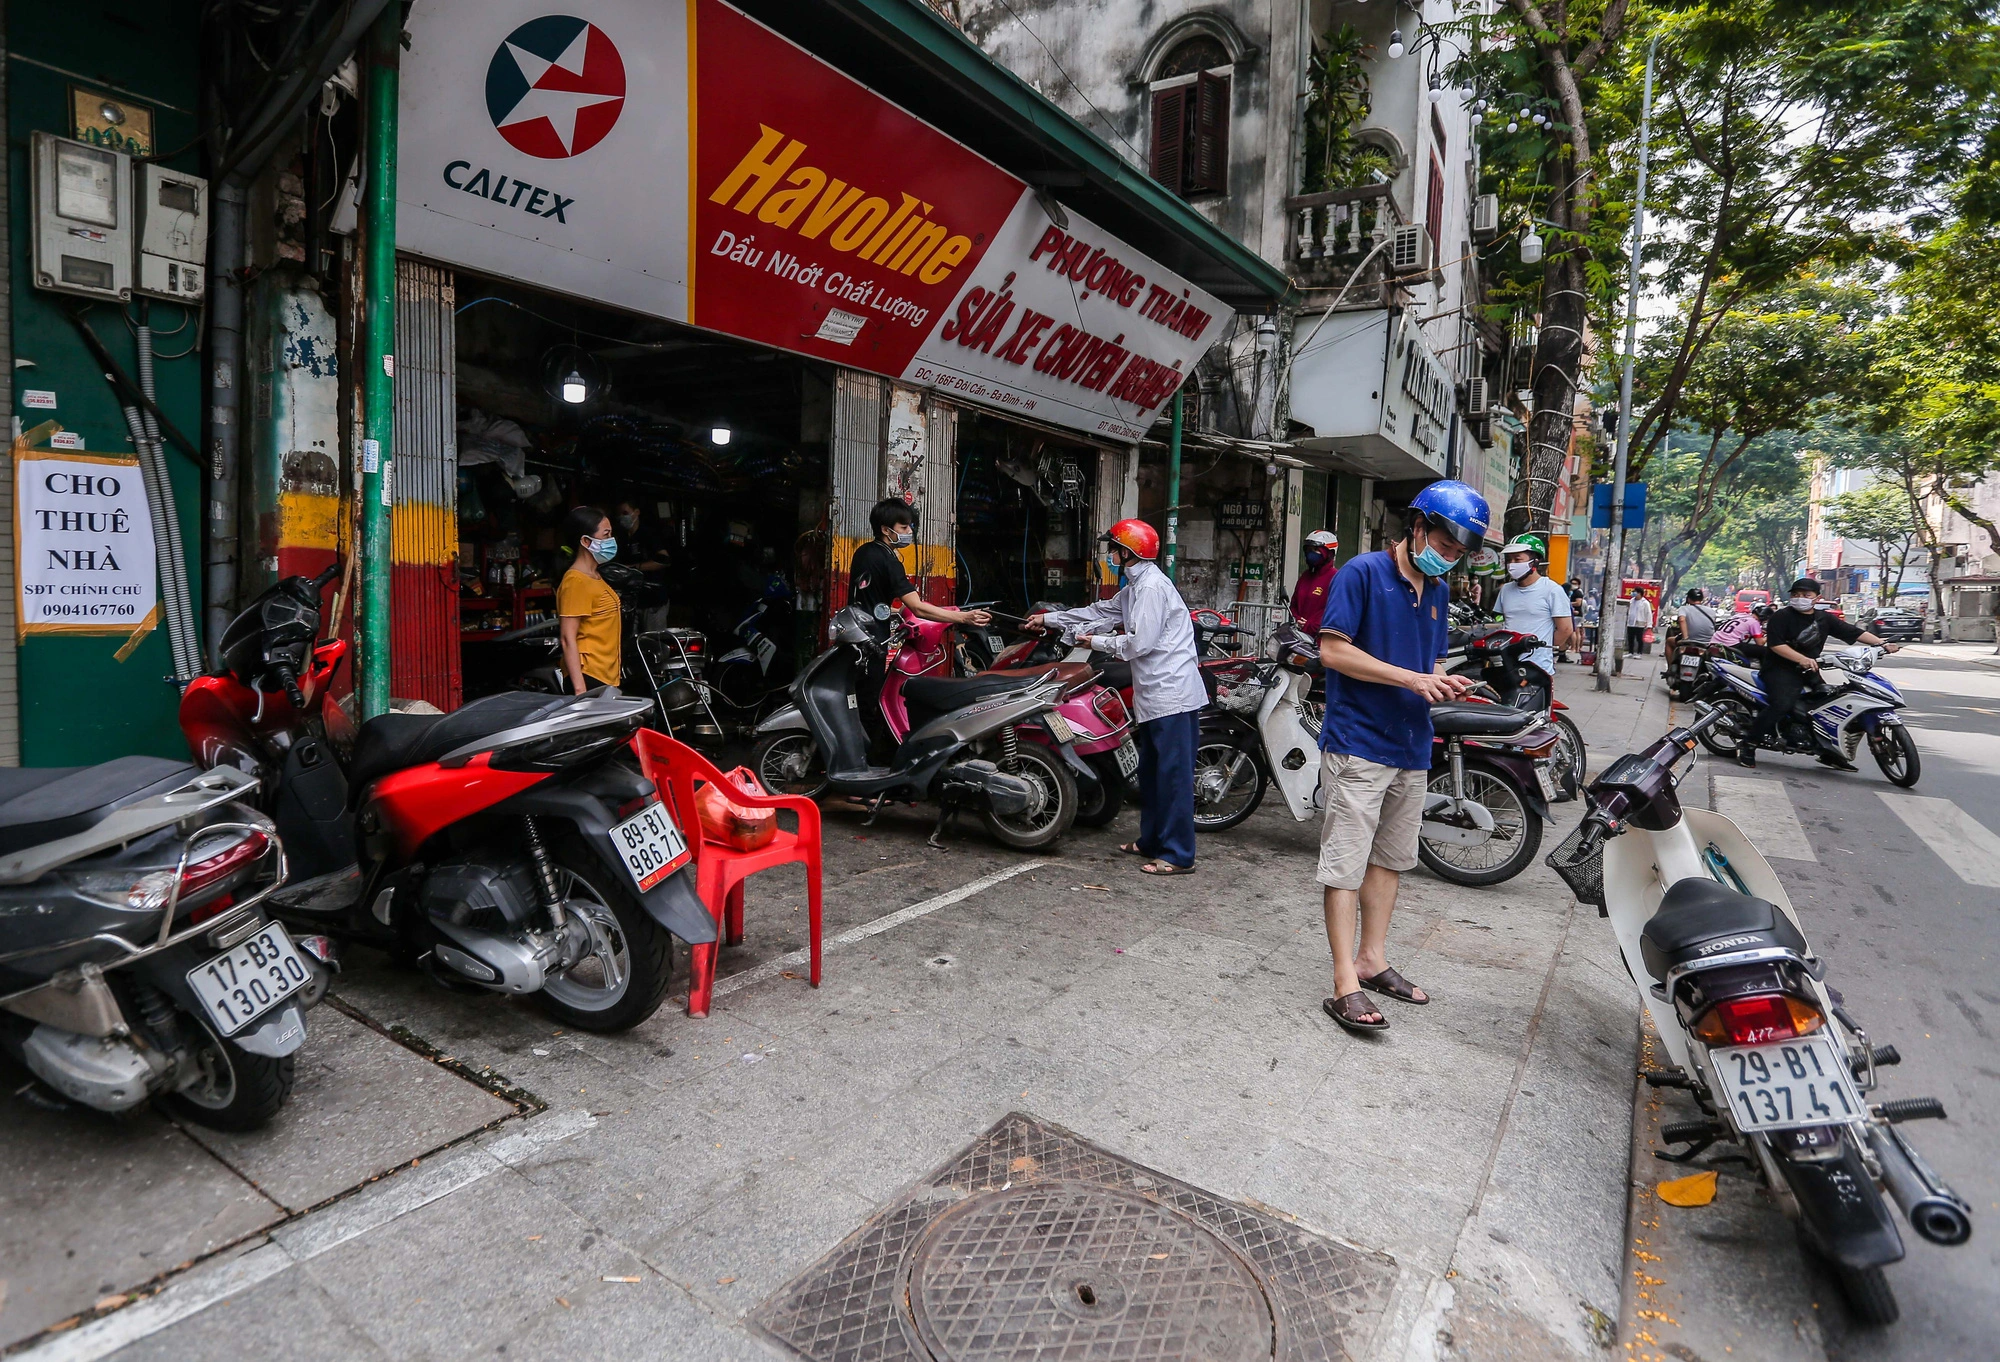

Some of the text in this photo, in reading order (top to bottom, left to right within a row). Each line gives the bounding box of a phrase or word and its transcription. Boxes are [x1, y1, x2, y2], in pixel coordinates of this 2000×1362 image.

[443, 160, 575, 224] CALTEX
[708, 122, 972, 285] Havoline
[710, 229, 764, 267] Dầu
[764, 249, 824, 288] Nhớt
[824, 271, 874, 306] Chất
[870, 287, 929, 328] Lượng
[1028, 225, 1213, 341] PHƯỢNG THÀNH
[941, 271, 1184, 417] SỬA XE CHUYÊN NGHIỆP
[914, 367, 934, 381] ĐC:
[934, 373, 956, 387] 166F
[990, 389, 1001, 400] Ba
[1023, 399, 1038, 411] HN
[45, 473, 121, 497] CHO
[35, 508, 130, 534] THUÊ
[46, 545, 121, 571] NHÀ
[24, 583, 142, 596] SĐT CHÍNH CHỦ
[42, 603, 135, 616] 0904167760
[1625, 588, 1658, 598] BN
[621, 809, 666, 849] 89-B1
[629, 830, 683, 876] 986.71
[643, 876, 655, 886] VIE
[207, 933, 280, 991] 17-B3
[1699, 935, 1764, 957] HONDA
[217, 956, 304, 1025] 130.30
[1730, 1043, 1825, 1086] 29-B1
[1738, 1081, 1852, 1124] 137.41
